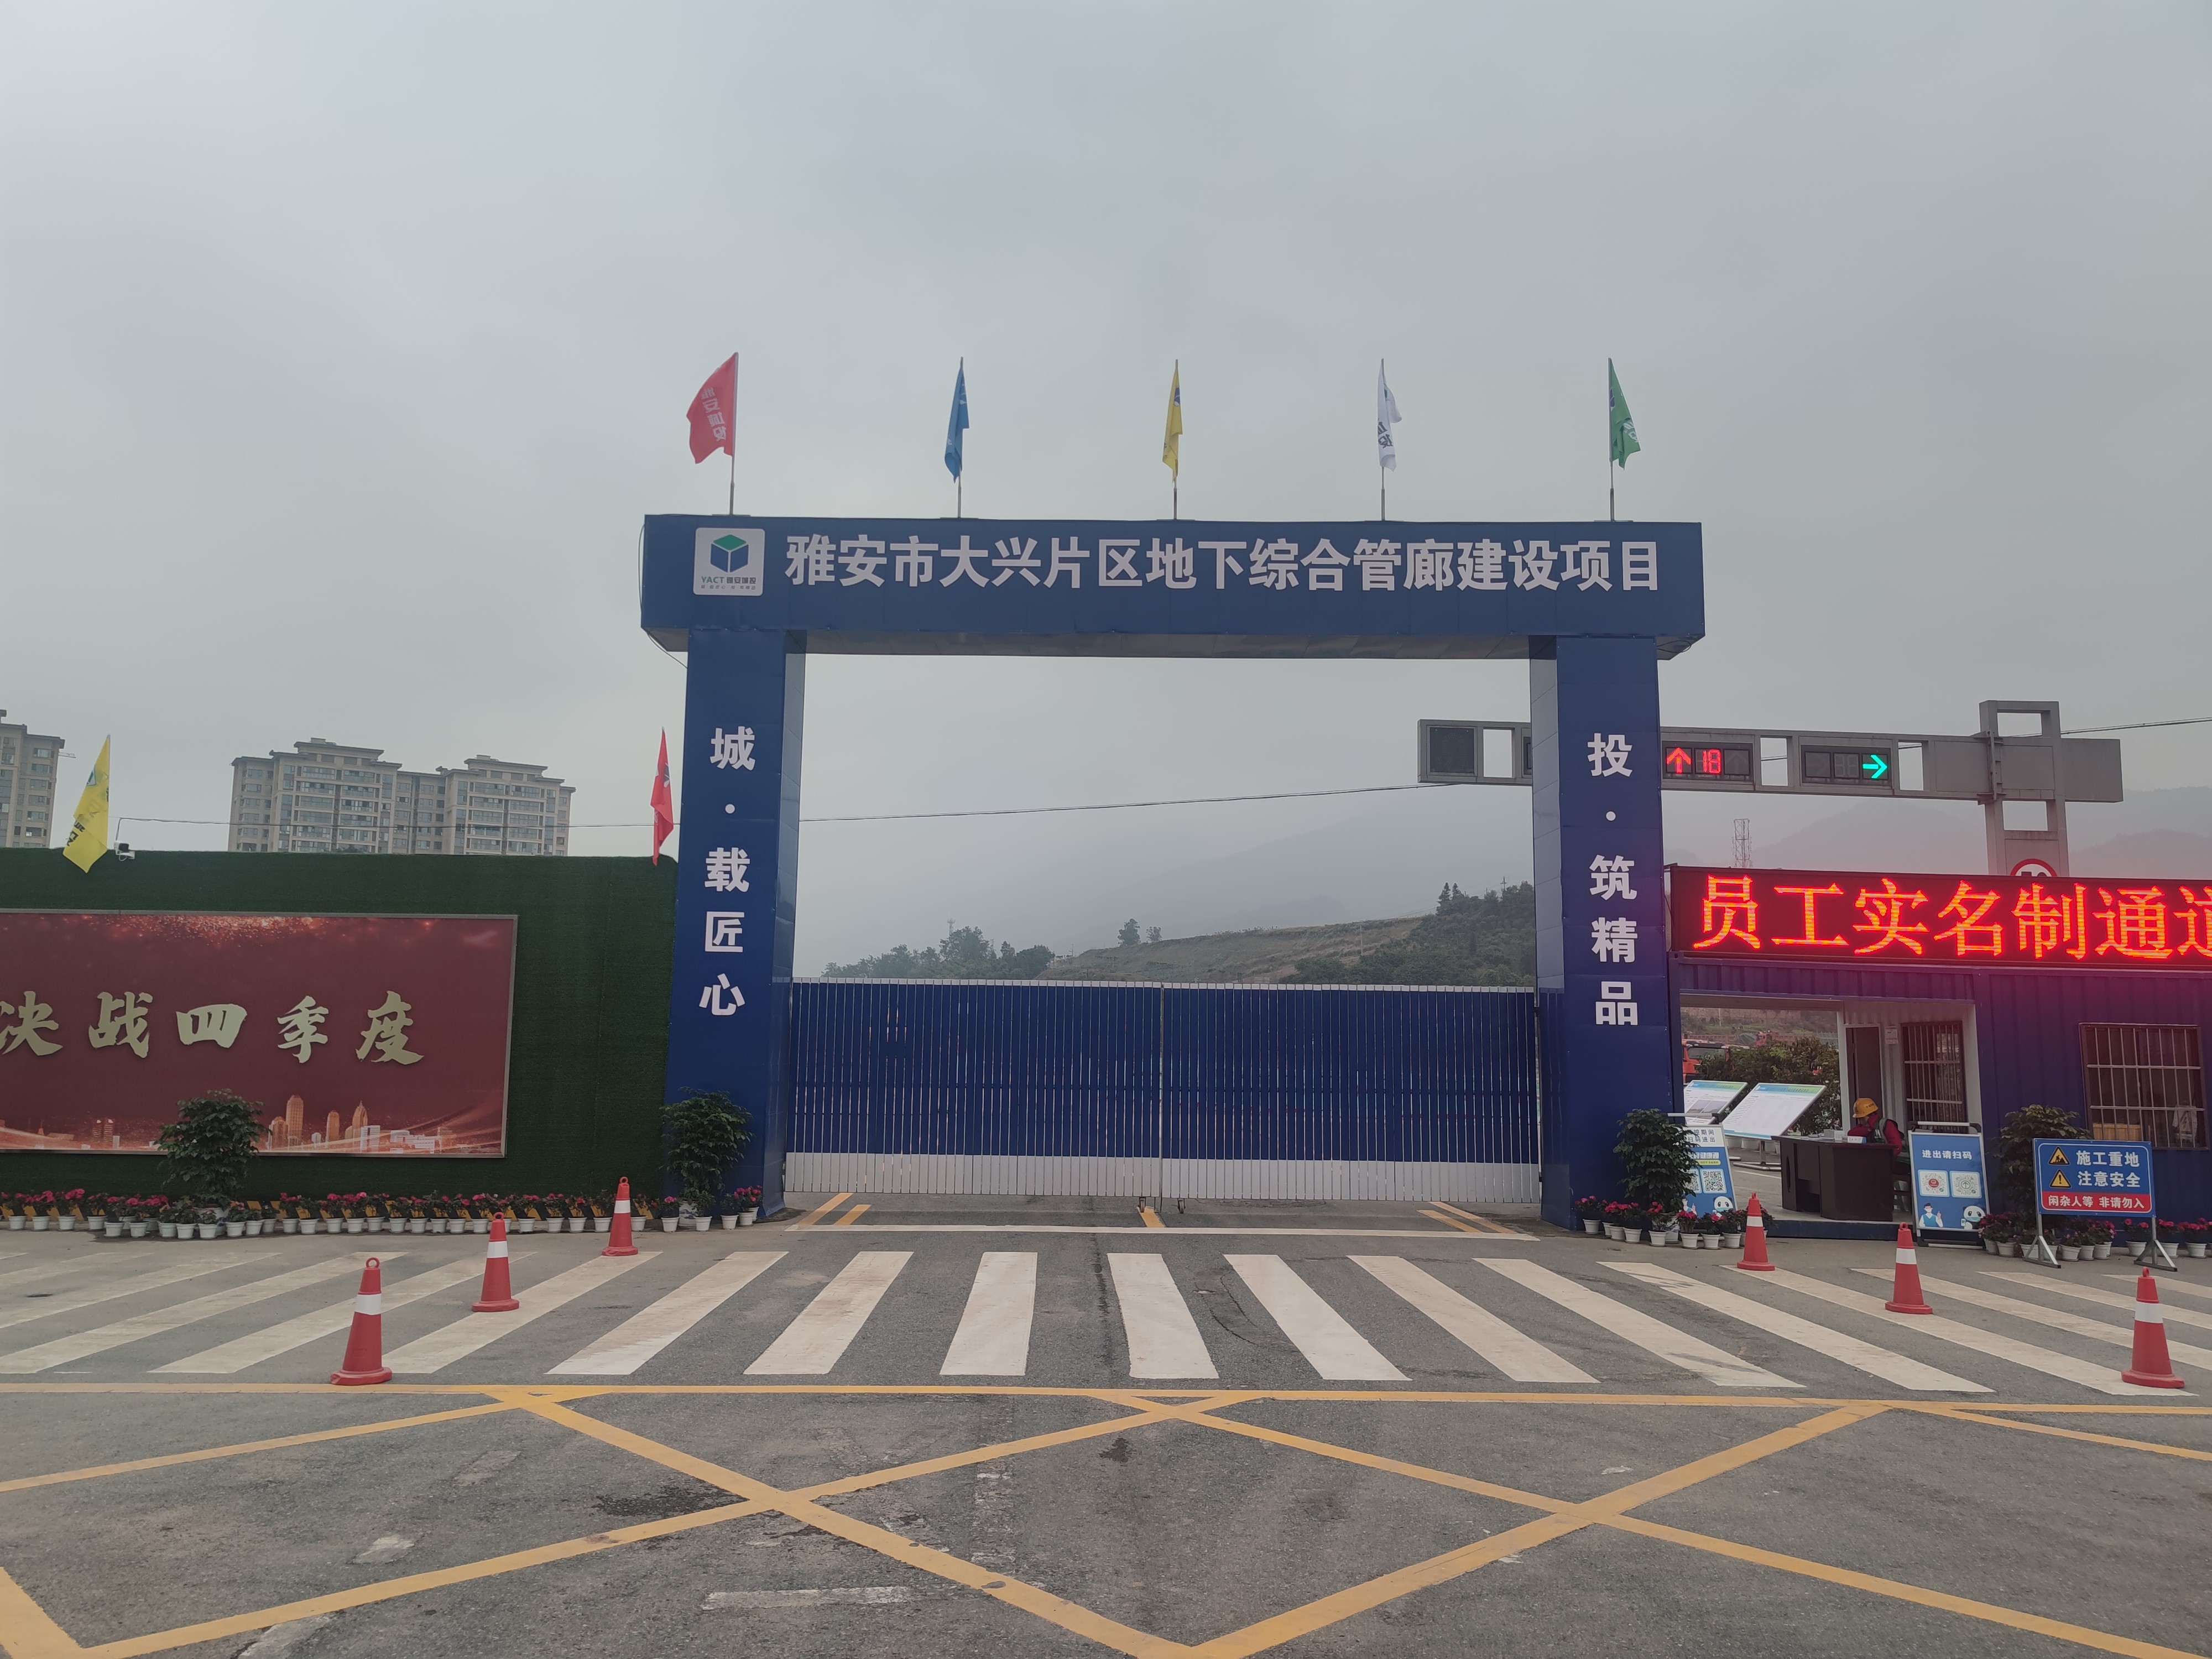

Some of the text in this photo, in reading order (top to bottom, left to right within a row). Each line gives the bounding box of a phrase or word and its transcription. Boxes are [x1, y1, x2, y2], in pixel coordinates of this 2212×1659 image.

[785, 534, 1658, 591] 雅安市大兴片区地下综合管廊建设项目
[1702, 749, 1721, 774] 18
[0, 990, 424, 1065] 决战四季度
[1922, 1150, 1972, 1160] 进出请扫码
[2077, 1150, 2140, 1167] 施工重地
[2077, 1171, 2141, 1187] 注意安全
[2048, 1195, 2145, 1209] 闲杂人等 非请勿入
